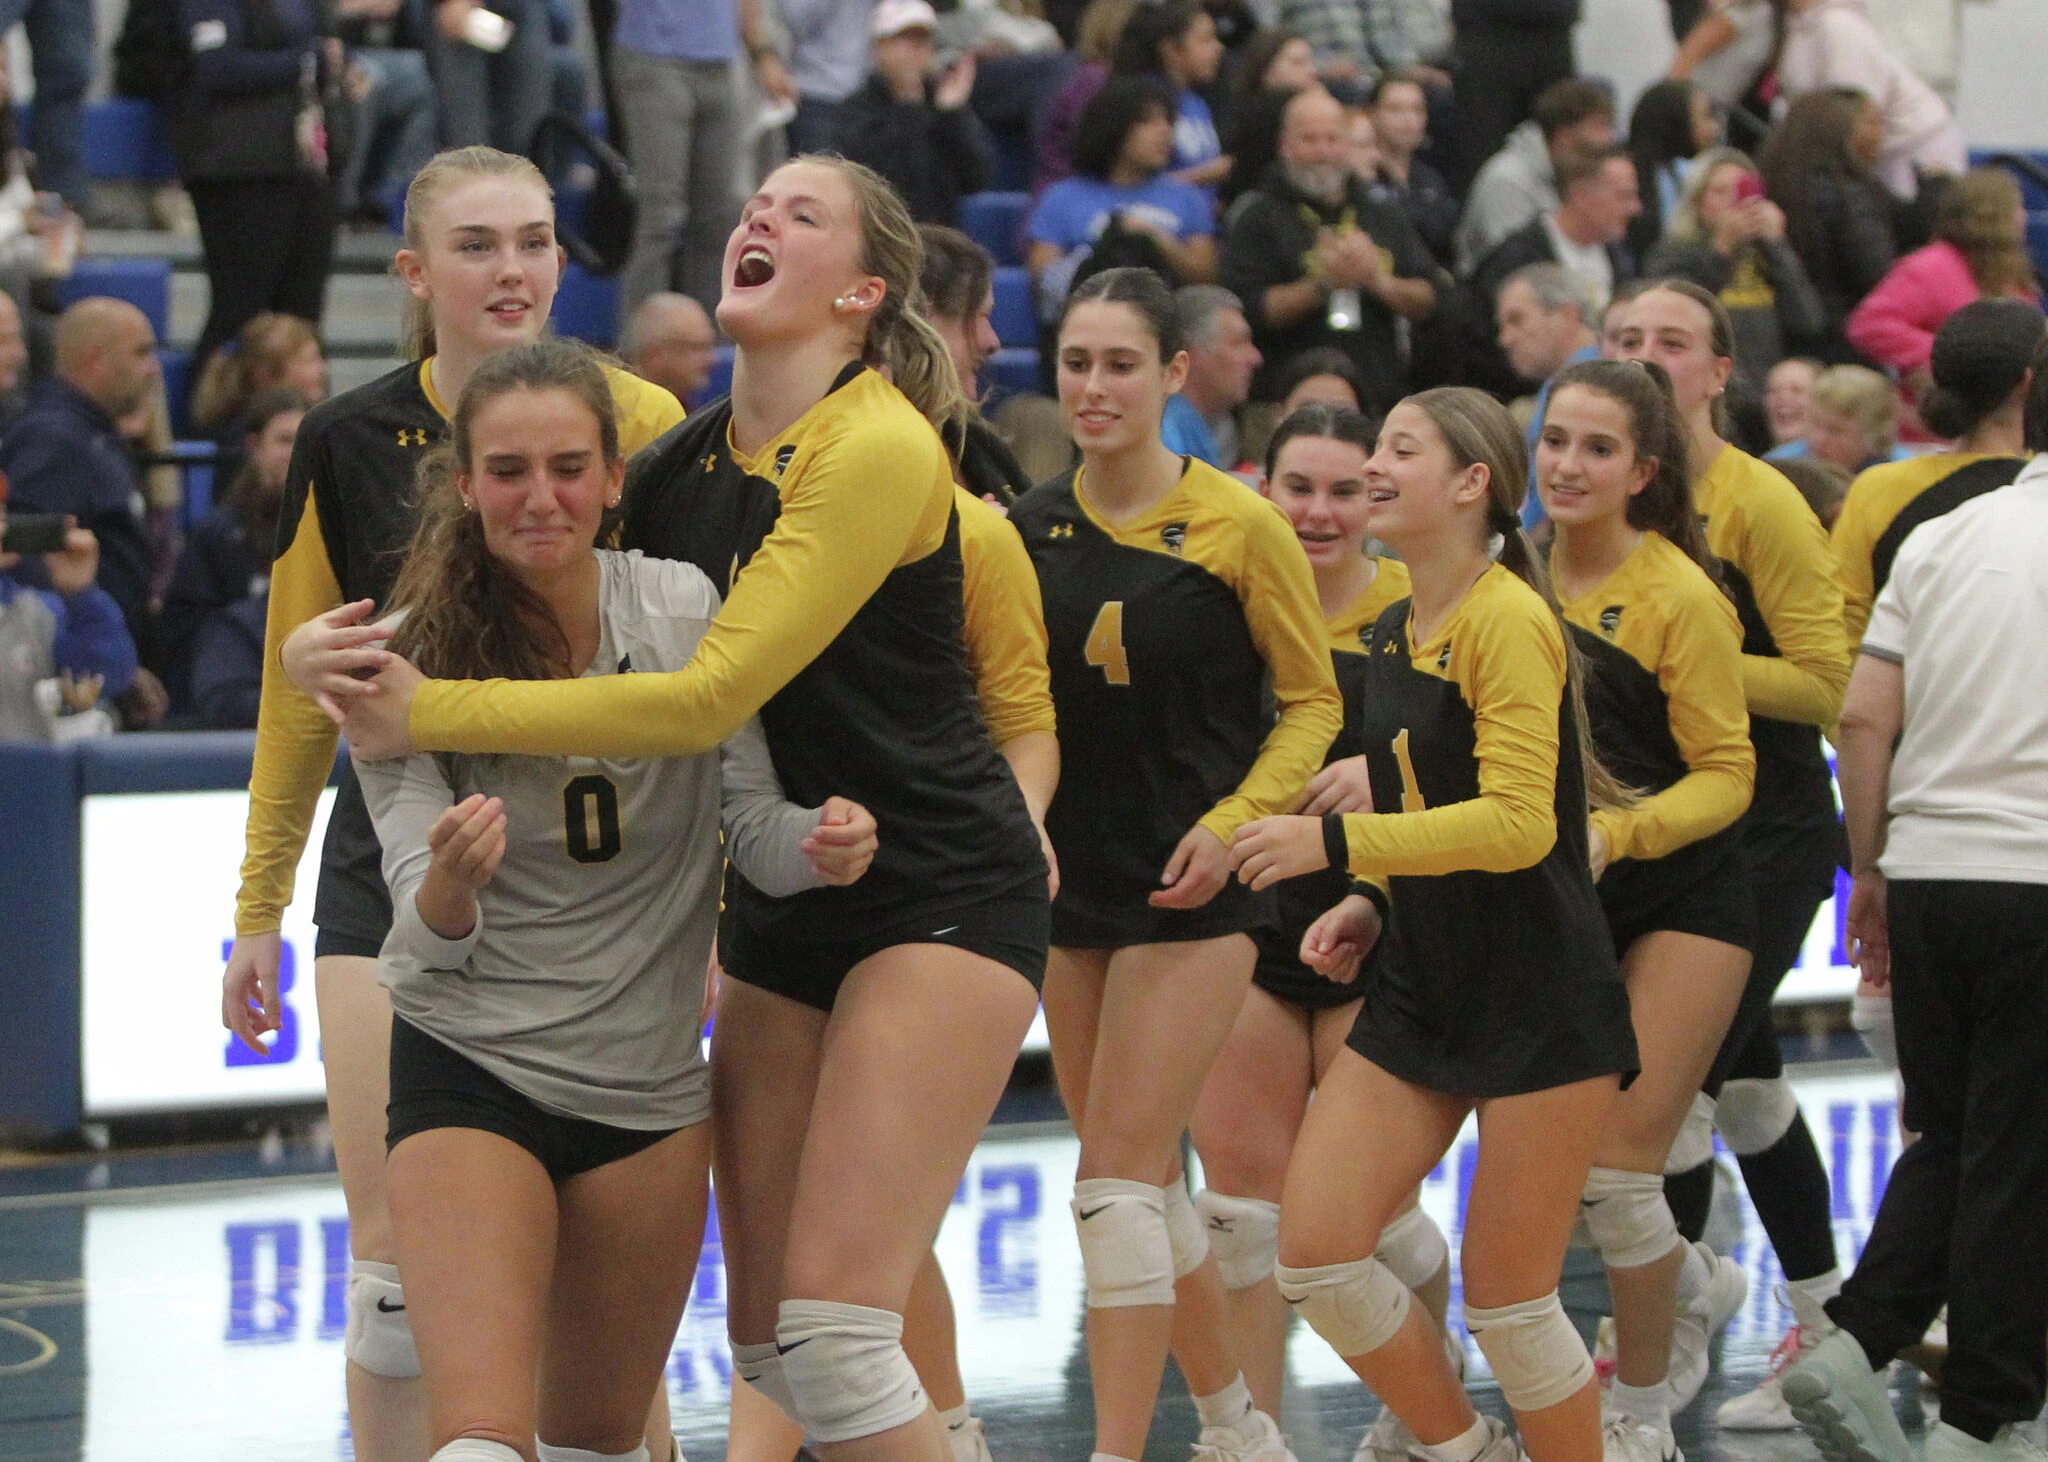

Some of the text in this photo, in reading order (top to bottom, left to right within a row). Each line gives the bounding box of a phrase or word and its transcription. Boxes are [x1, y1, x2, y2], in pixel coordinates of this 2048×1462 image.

[1084, 600, 1131, 685] 4
[1392, 727, 1426, 814] 1
[562, 773, 623, 865] 0
